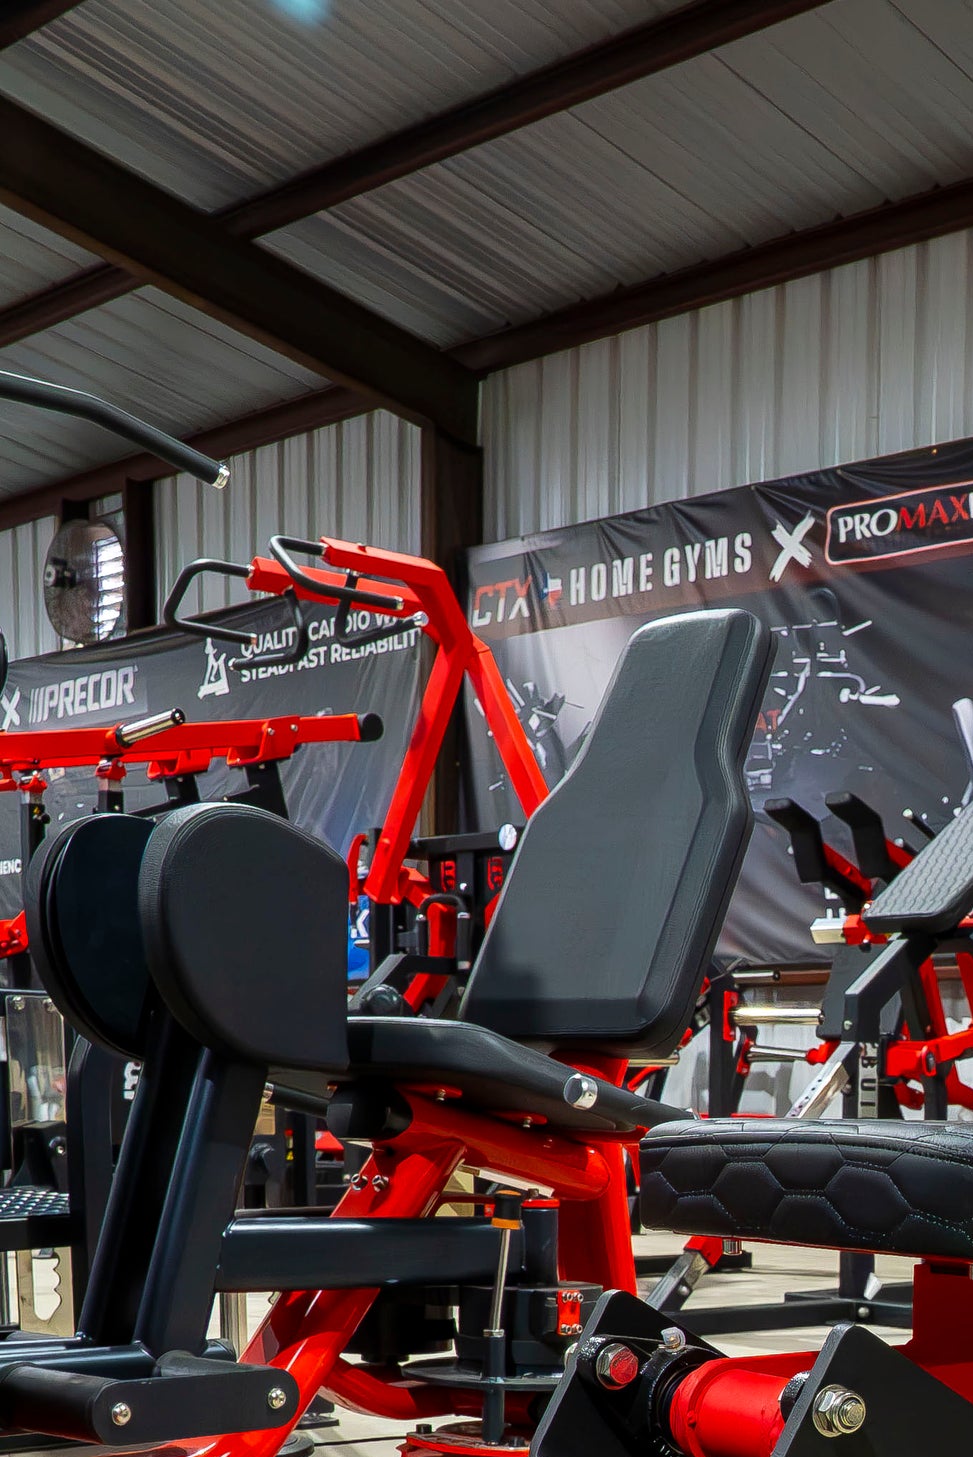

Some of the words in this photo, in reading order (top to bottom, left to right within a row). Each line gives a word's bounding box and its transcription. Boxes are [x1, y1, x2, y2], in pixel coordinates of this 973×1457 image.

[472, 574, 533, 627] CTX
[569, 552, 653, 606] HOME
[663, 532, 752, 588] GYMS
[43, 666, 135, 721] PRECOR
